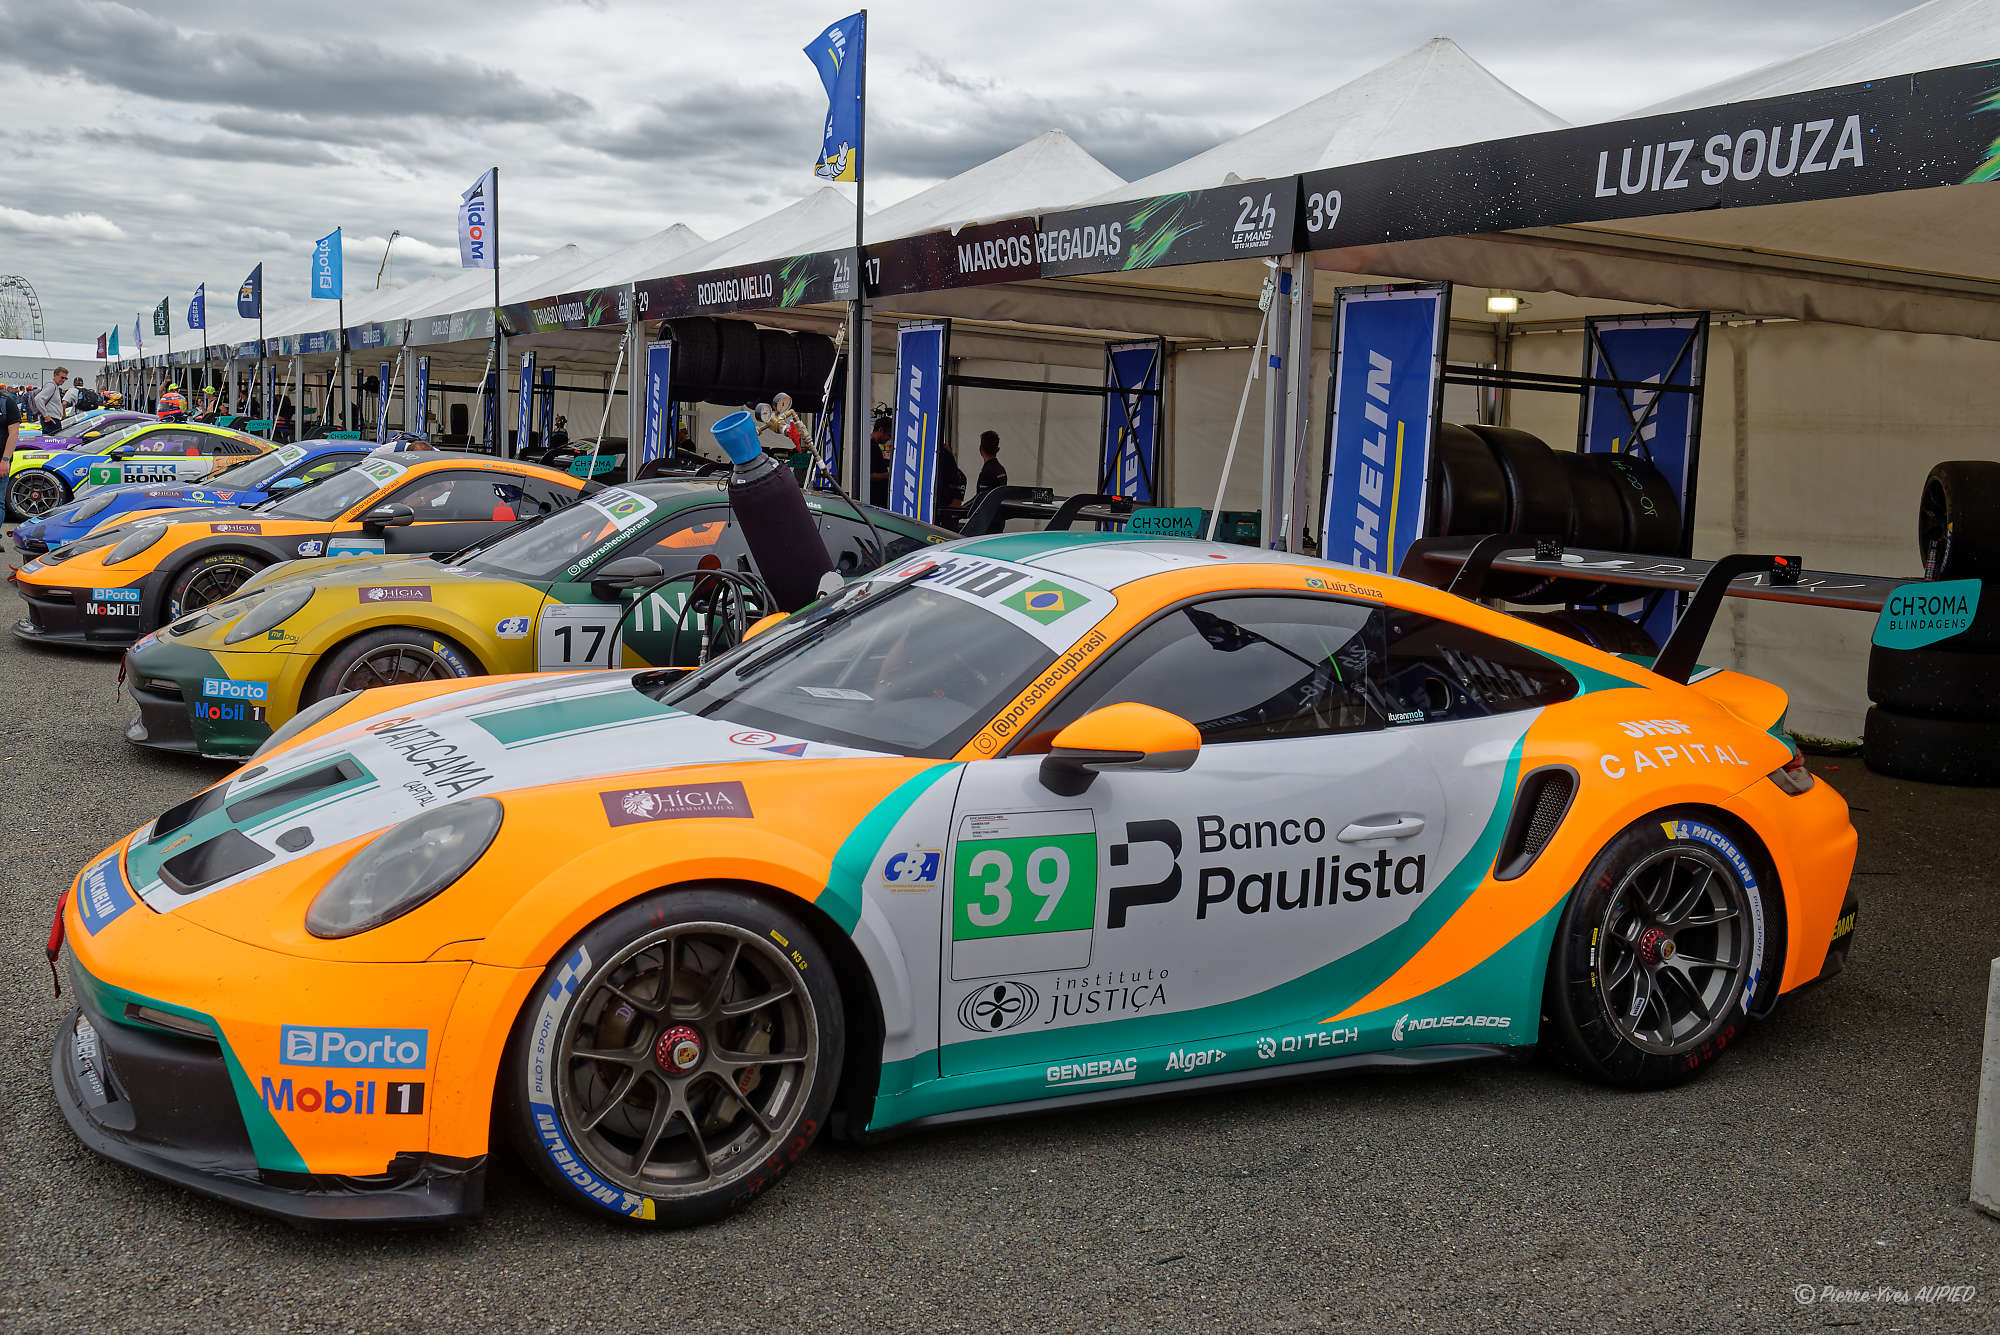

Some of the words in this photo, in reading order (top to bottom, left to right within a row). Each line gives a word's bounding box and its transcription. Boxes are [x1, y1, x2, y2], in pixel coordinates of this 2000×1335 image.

[1595, 139, 1696, 197] LUIZ
[1701, 114, 1864, 186] SOUZA
[1307, 190, 1342, 232] 39
[958, 232, 1031, 274] MARCOS
[1036, 222, 1121, 262] REGADAS
[1232, 233, 1243, 243] LE
[1244, 230, 1272, 242] MANS
[865, 257, 880, 285] 17
[639, 291, 649, 311] 29
[698, 279, 740, 306] RODRIGO
[740, 274, 773, 301] MELLO
[534, 306, 558, 325] THIAGO
[100, 469, 111, 484] 9
[124, 464, 176, 473] TEK
[124, 475, 176, 484] BOND
[350, 480, 400, 516] @porschecupbrasil
[1132, 517, 1193, 529] CHROMA
[579, 517, 651, 568] @porschecupbrasil
[106, 590, 138, 600] Porto
[1324, 579, 1348, 592] Luiz
[1349, 583, 1384, 598] Souza
[87, 602, 124, 616] Mobil
[1890, 595, 1968, 616] CHROMA
[497, 617, 528, 633] CBA
[1890, 619, 1966, 630] BLINDAGENS
[554, 625, 606, 663] 17
[220, 684, 264, 699] Porto
[992, 629, 1108, 737] @porschecupbrasil
[195, 702, 244, 721] Mobil
[1618, 719, 1693, 738] JHSF
[1600, 744, 1749, 779] CAPITAL
[402, 780, 438, 807] CAPITAL
[653, 790, 733, 810] HÍGIA
[1196, 814, 1326, 853] Banco
[884, 852, 941, 881] CBA
[1692, 825, 1753, 882] MICHELIN
[89, 870, 117, 919] MICHELIN
[966, 846, 1071, 927] 39
[1196, 849, 1426, 920] Paulista
[1055, 968, 1169, 991] instituto
[1044, 983, 1167, 1024] JUSTIÇA
[537, 1011, 554, 1056] SPORT
[1408, 1015, 1511, 1032] INDUSCABOS
[77, 1026, 97, 1061] DENER
[322, 1032, 420, 1063] Porto
[1046, 1057, 1137, 1082] GENERAC
[1165, 1048, 1216, 1074] Algar
[535, 1058, 543, 1093] PILOT
[261, 1076, 376, 1115] Mobil
[537, 1113, 620, 1205] MICHELIN
